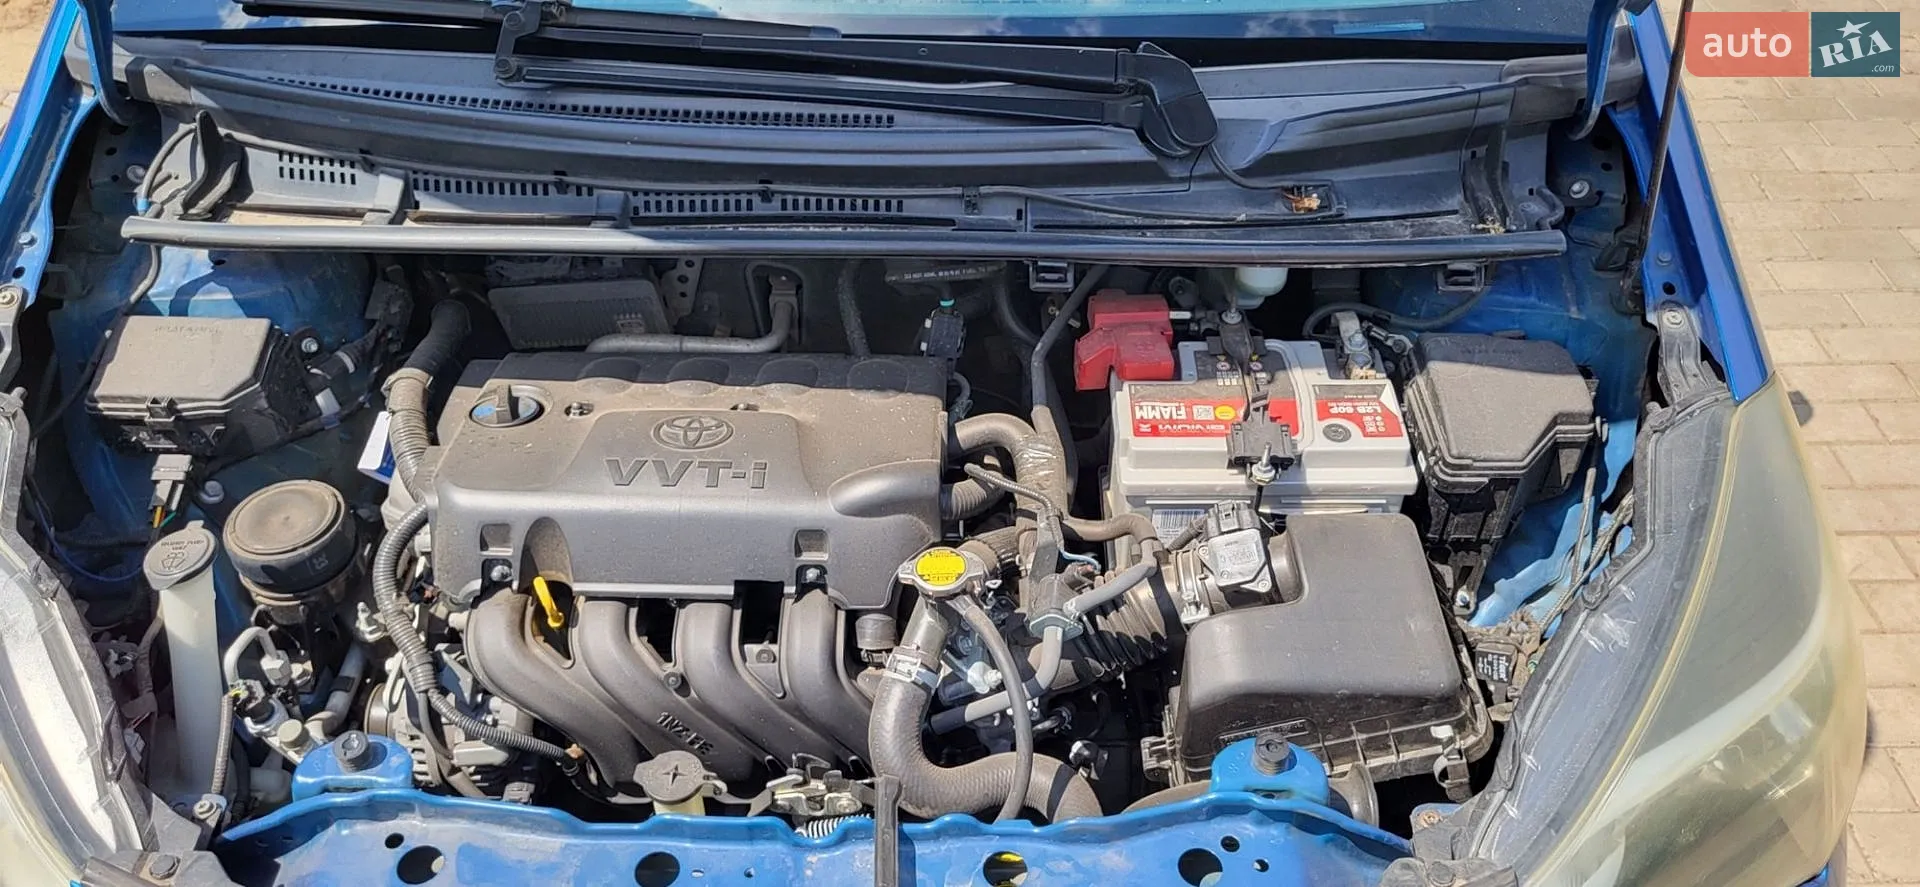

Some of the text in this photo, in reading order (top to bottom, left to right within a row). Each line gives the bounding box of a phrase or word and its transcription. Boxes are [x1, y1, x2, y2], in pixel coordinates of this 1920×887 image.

[1135, 405, 1187, 420] FIAMM
[604, 458, 768, 489] VVT-i
[656, 711, 714, 756] 1NZ-FE
